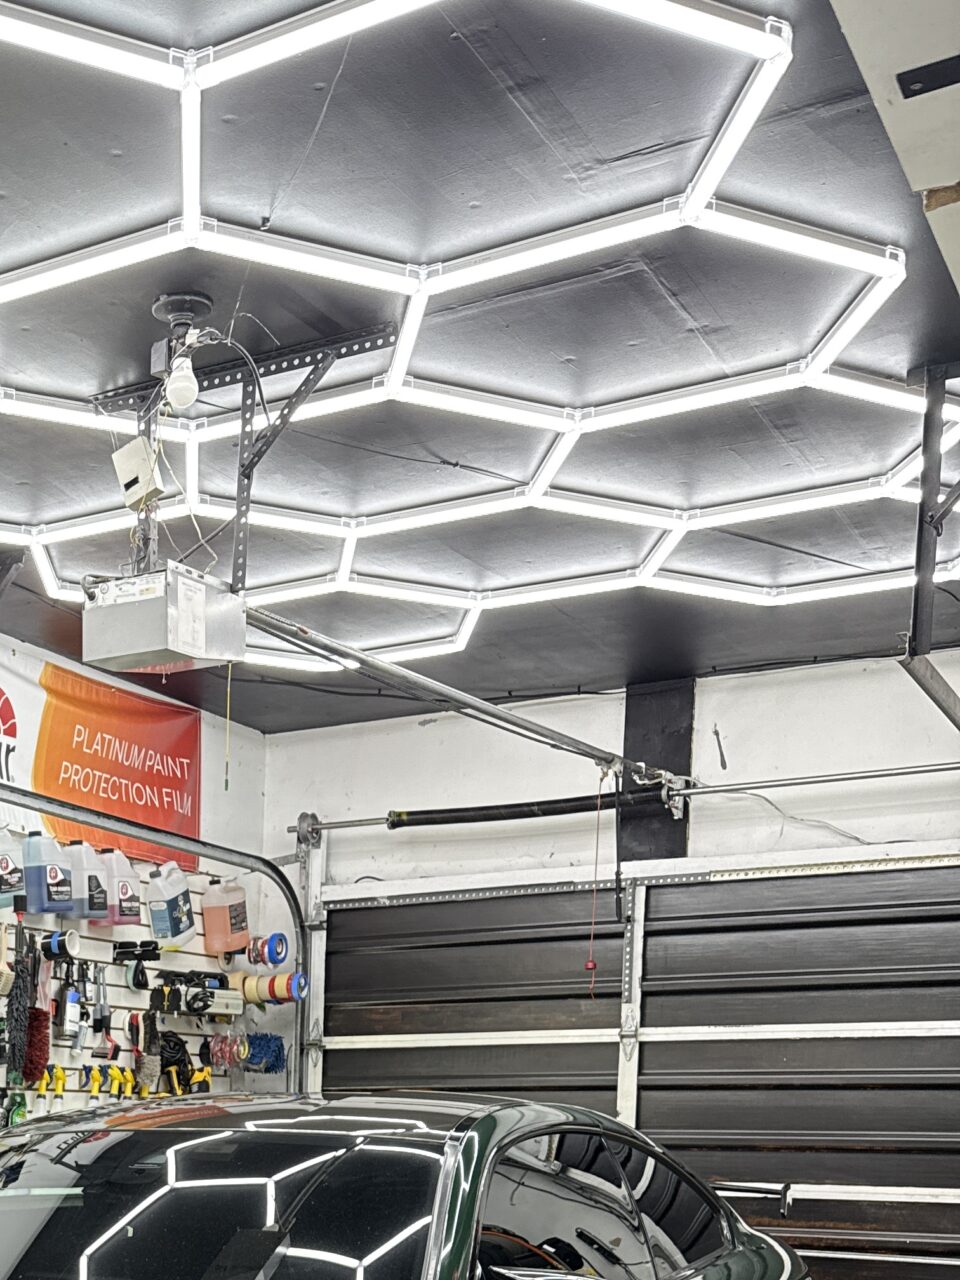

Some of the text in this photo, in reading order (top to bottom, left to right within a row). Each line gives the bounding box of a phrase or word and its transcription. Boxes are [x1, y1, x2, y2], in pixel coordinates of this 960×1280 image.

[72, 724, 191, 780] PLATINUM PAINT
[58, 761, 192, 817] PROTECTION FILM
